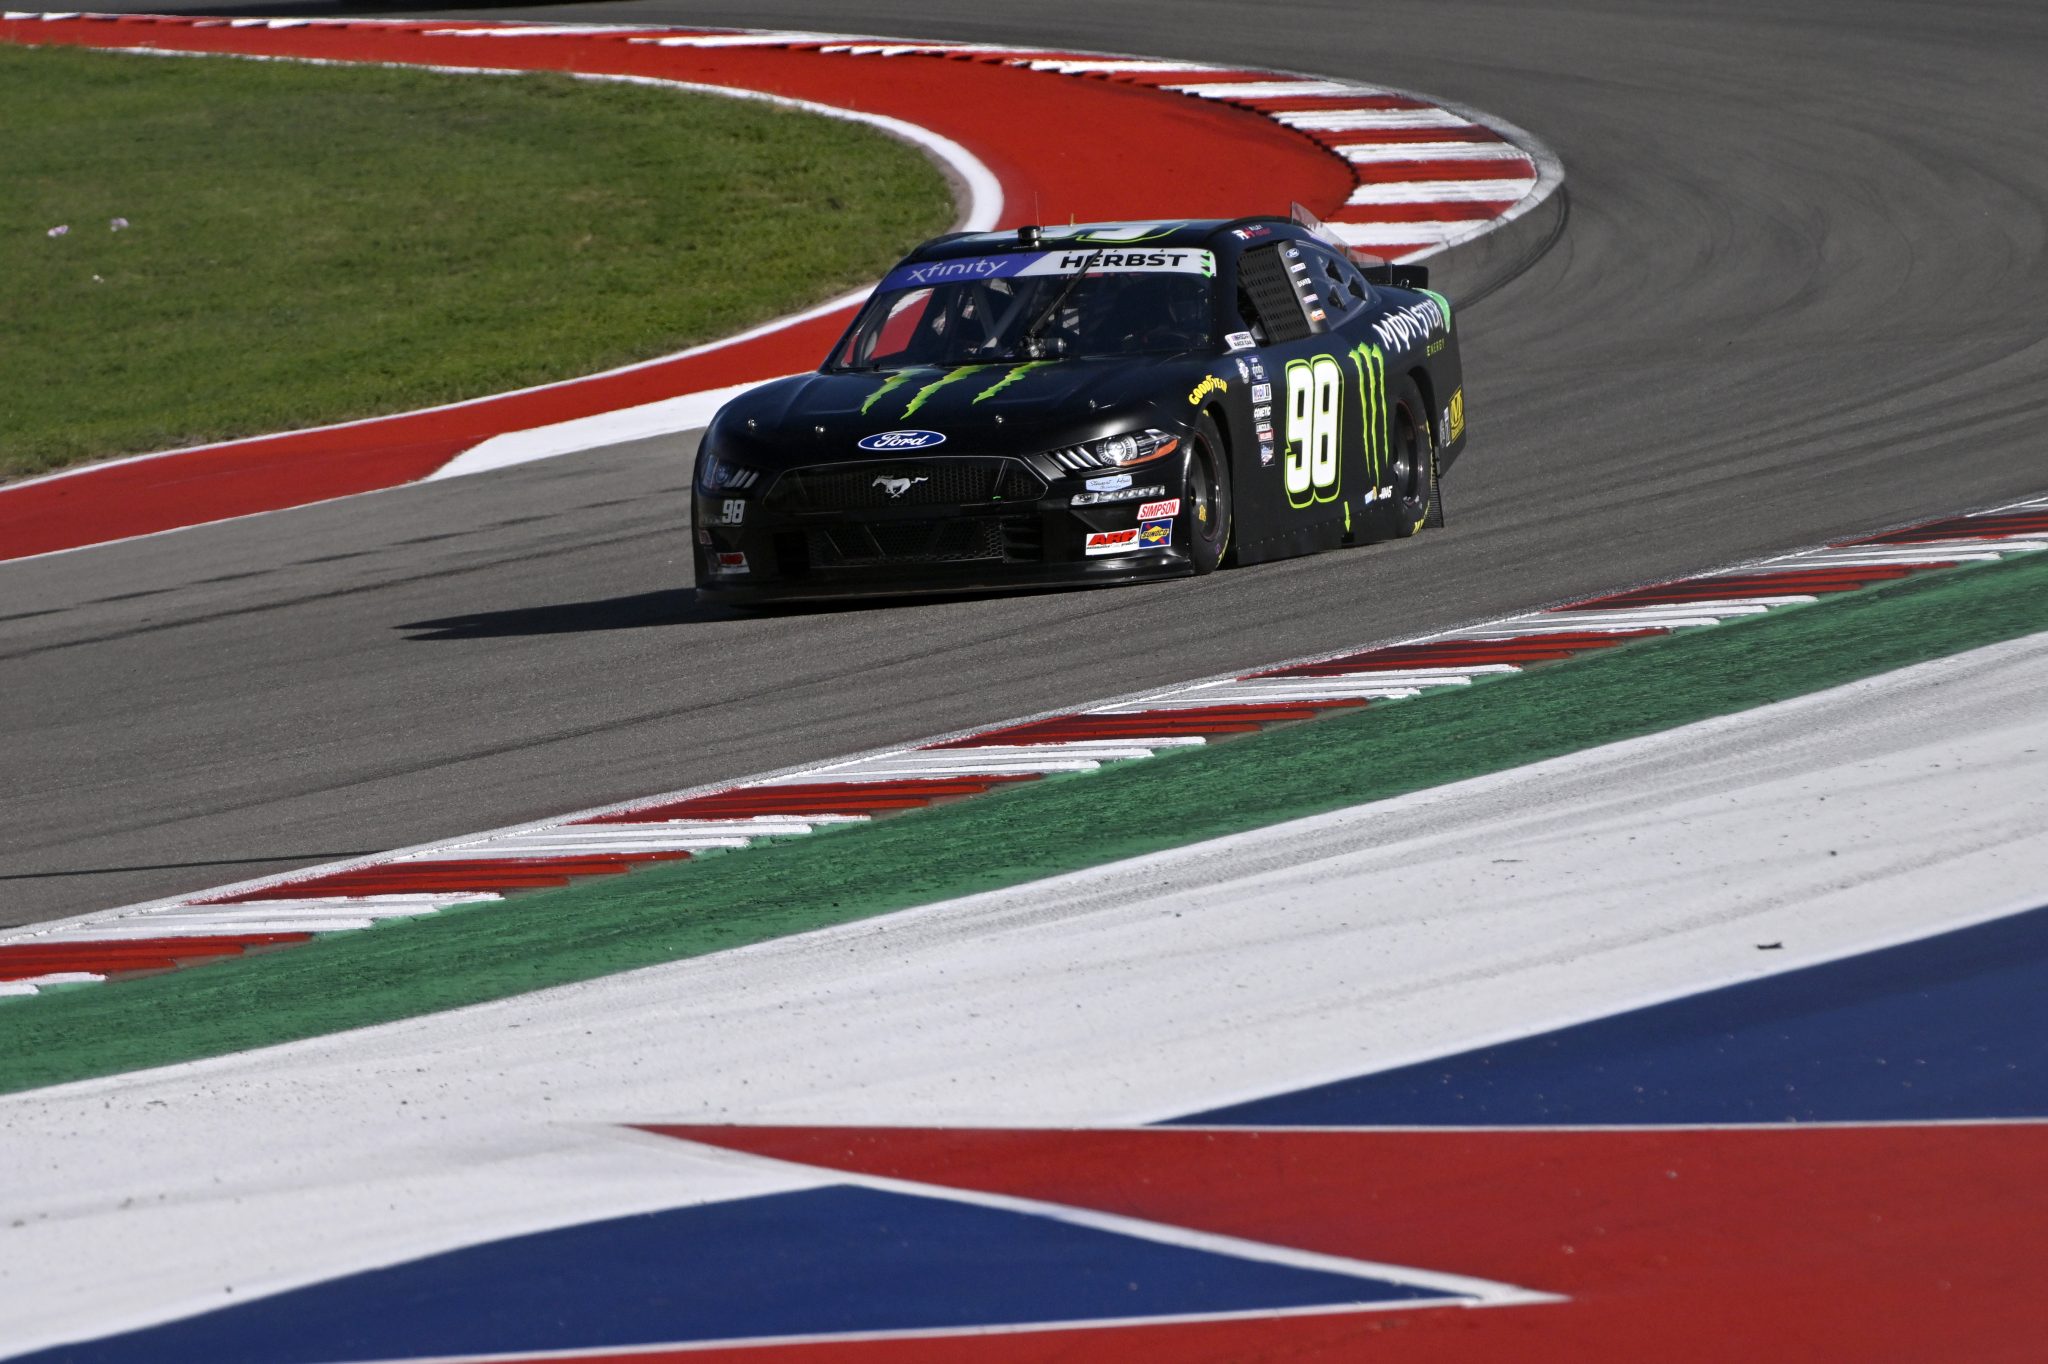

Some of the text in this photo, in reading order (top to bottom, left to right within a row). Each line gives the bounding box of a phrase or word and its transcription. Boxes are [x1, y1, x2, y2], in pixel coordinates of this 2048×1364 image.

[907, 258, 1008, 283] xfinity
[1060, 254, 1188, 268] HERBST
[1372, 299, 1444, 353] MONSTER
[1188, 374, 1228, 405] GOODYEAR
[873, 432, 930, 448] Ford
[1285, 354, 1344, 508] 98
[721, 499, 746, 524] 98
[1140, 502, 1177, 518] SIMPSON
[1087, 529, 1137, 546] ARP
[1142, 529, 1169, 539] SUNOCO
